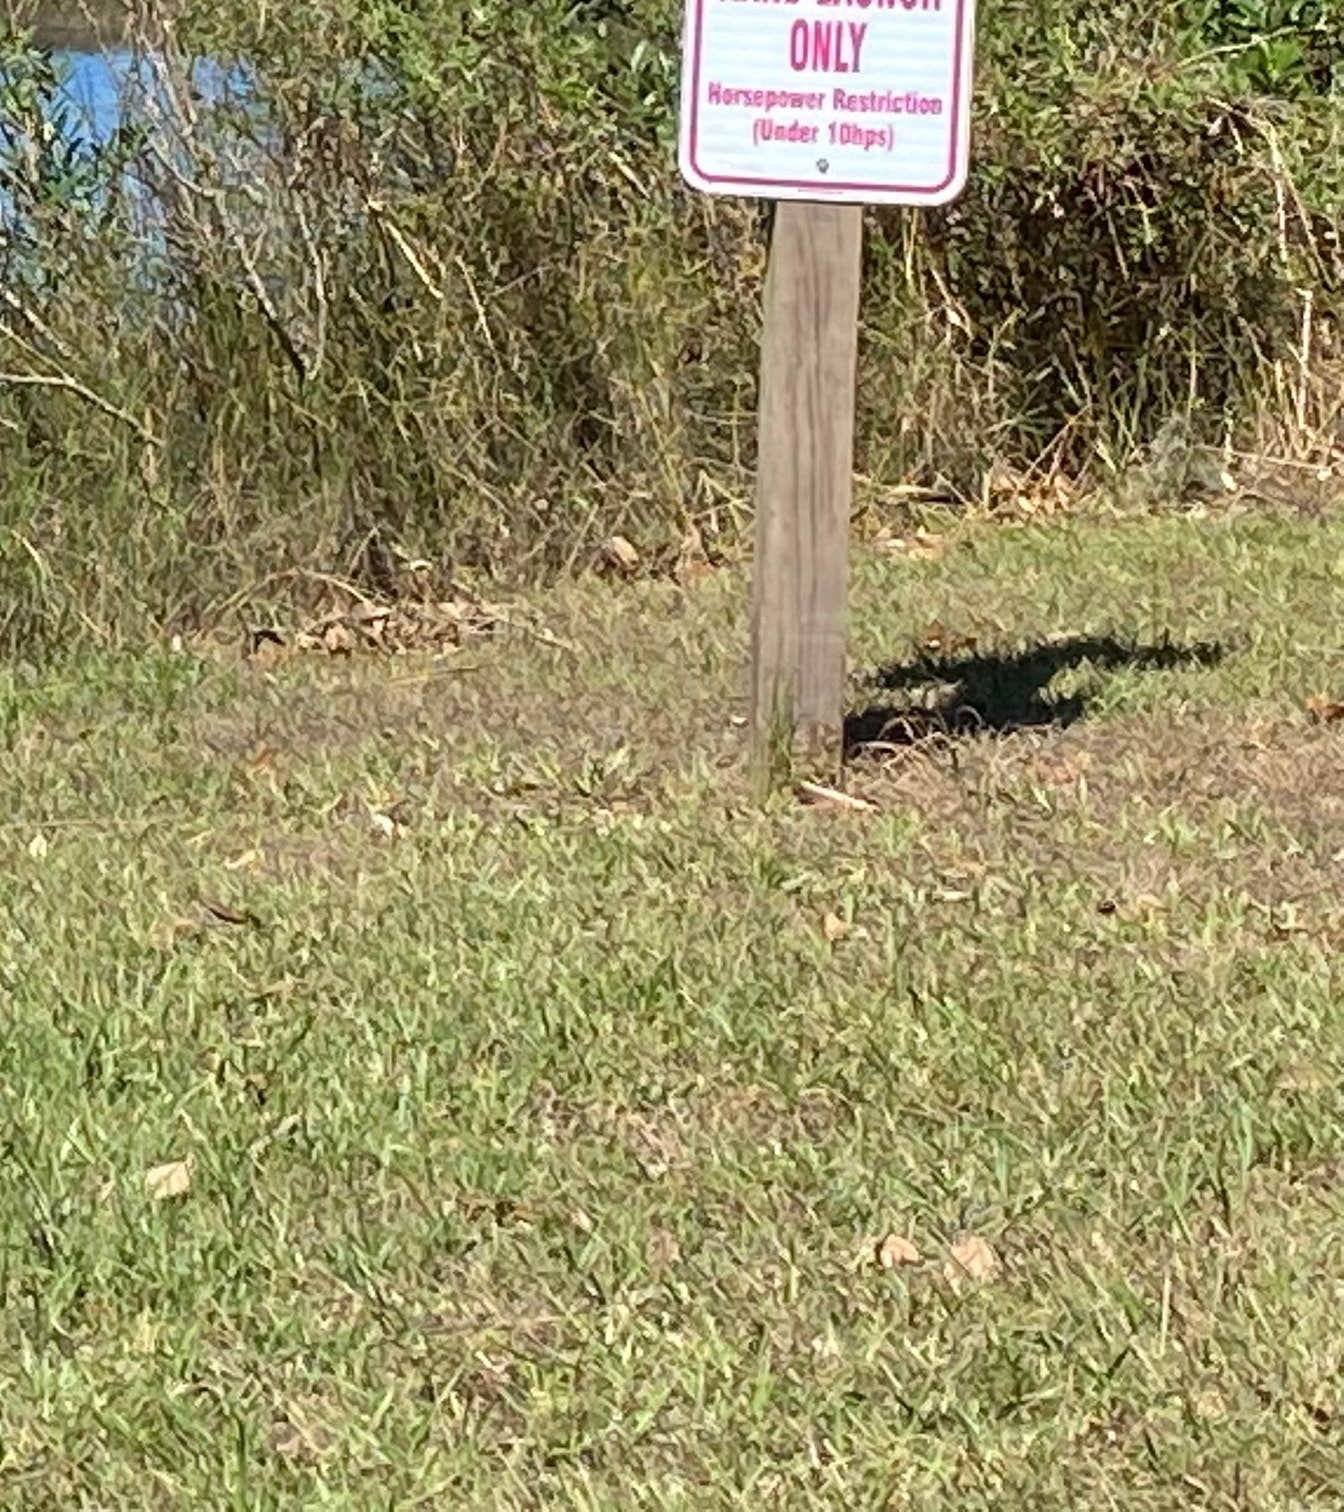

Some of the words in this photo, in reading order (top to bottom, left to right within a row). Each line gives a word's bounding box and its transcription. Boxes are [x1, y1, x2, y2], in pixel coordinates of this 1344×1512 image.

[789, 18, 869, 74] ONLY
[707, 80, 826, 113] Horsepower
[832, 87, 943, 115] Restriction
[752, 118, 820, 147] (Under
[827, 121, 895, 152] 10hps)
